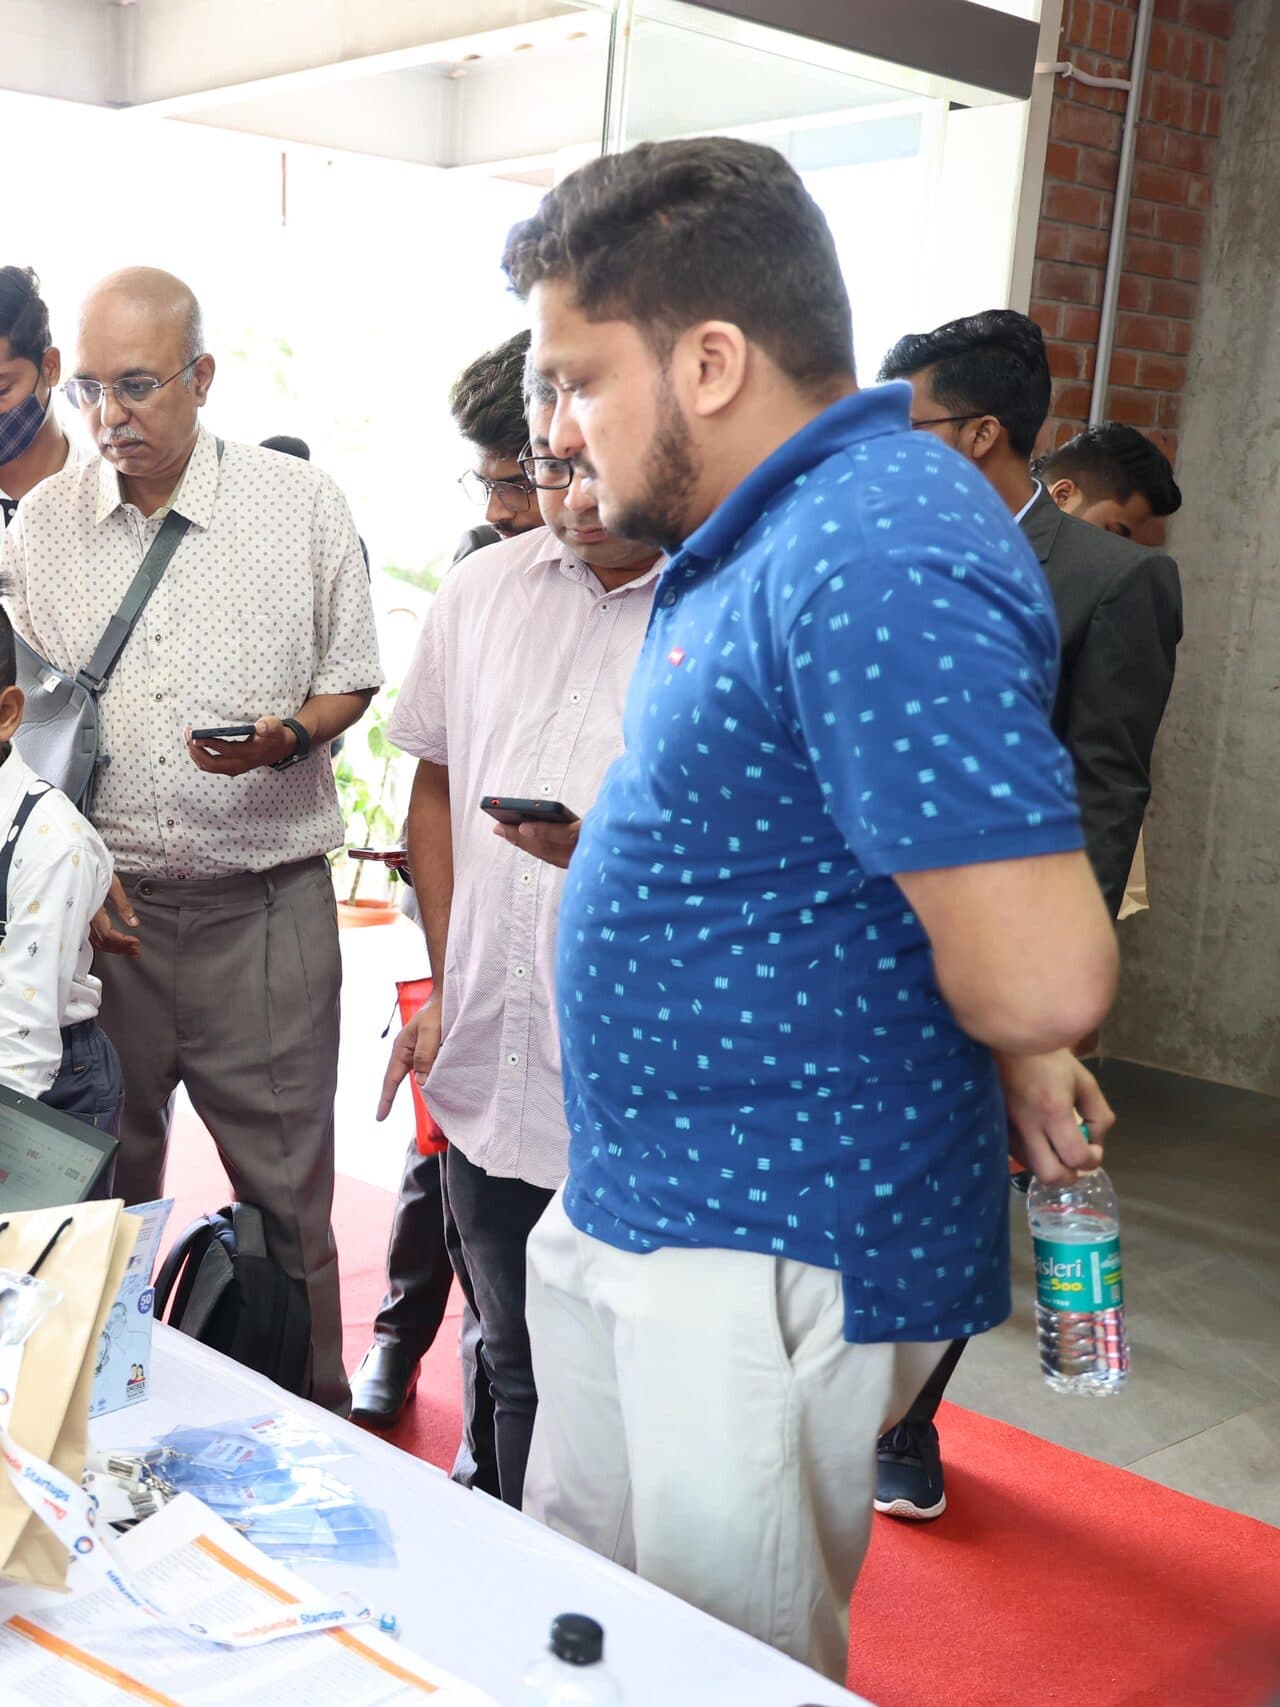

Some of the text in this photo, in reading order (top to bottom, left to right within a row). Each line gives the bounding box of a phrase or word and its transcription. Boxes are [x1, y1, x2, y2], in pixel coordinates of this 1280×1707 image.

[1035, 1256, 1082, 1278] isleri
[1051, 1278, 1083, 1292] 500
[23, 1466, 71, 1502] Startups
